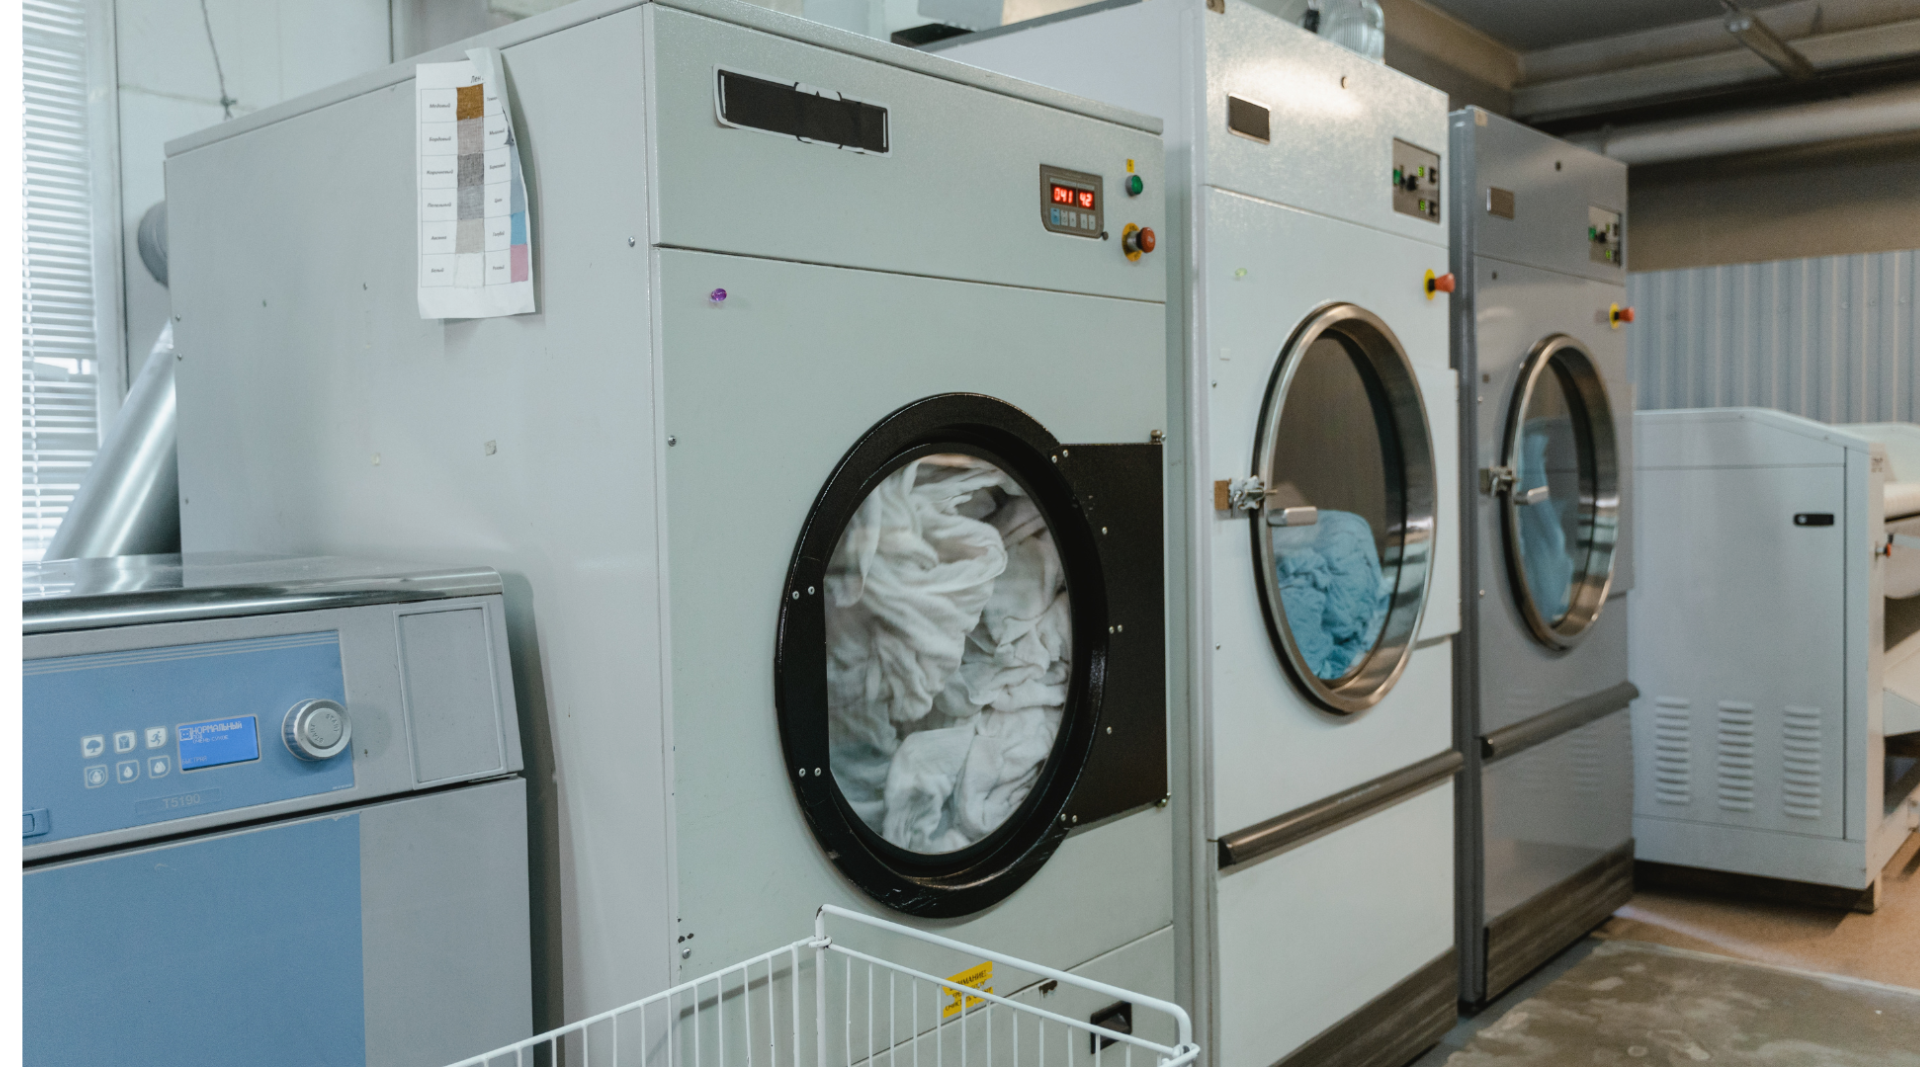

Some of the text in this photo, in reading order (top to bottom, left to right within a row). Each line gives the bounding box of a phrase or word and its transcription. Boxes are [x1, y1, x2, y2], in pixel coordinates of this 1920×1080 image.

[1054, 187, 1093, 207] 041 42
[192, 721, 243, 734] НОРМАЛЬНЫЙ
[310, 722, 324, 744] START
[162, 793, 201, 809] T5190
